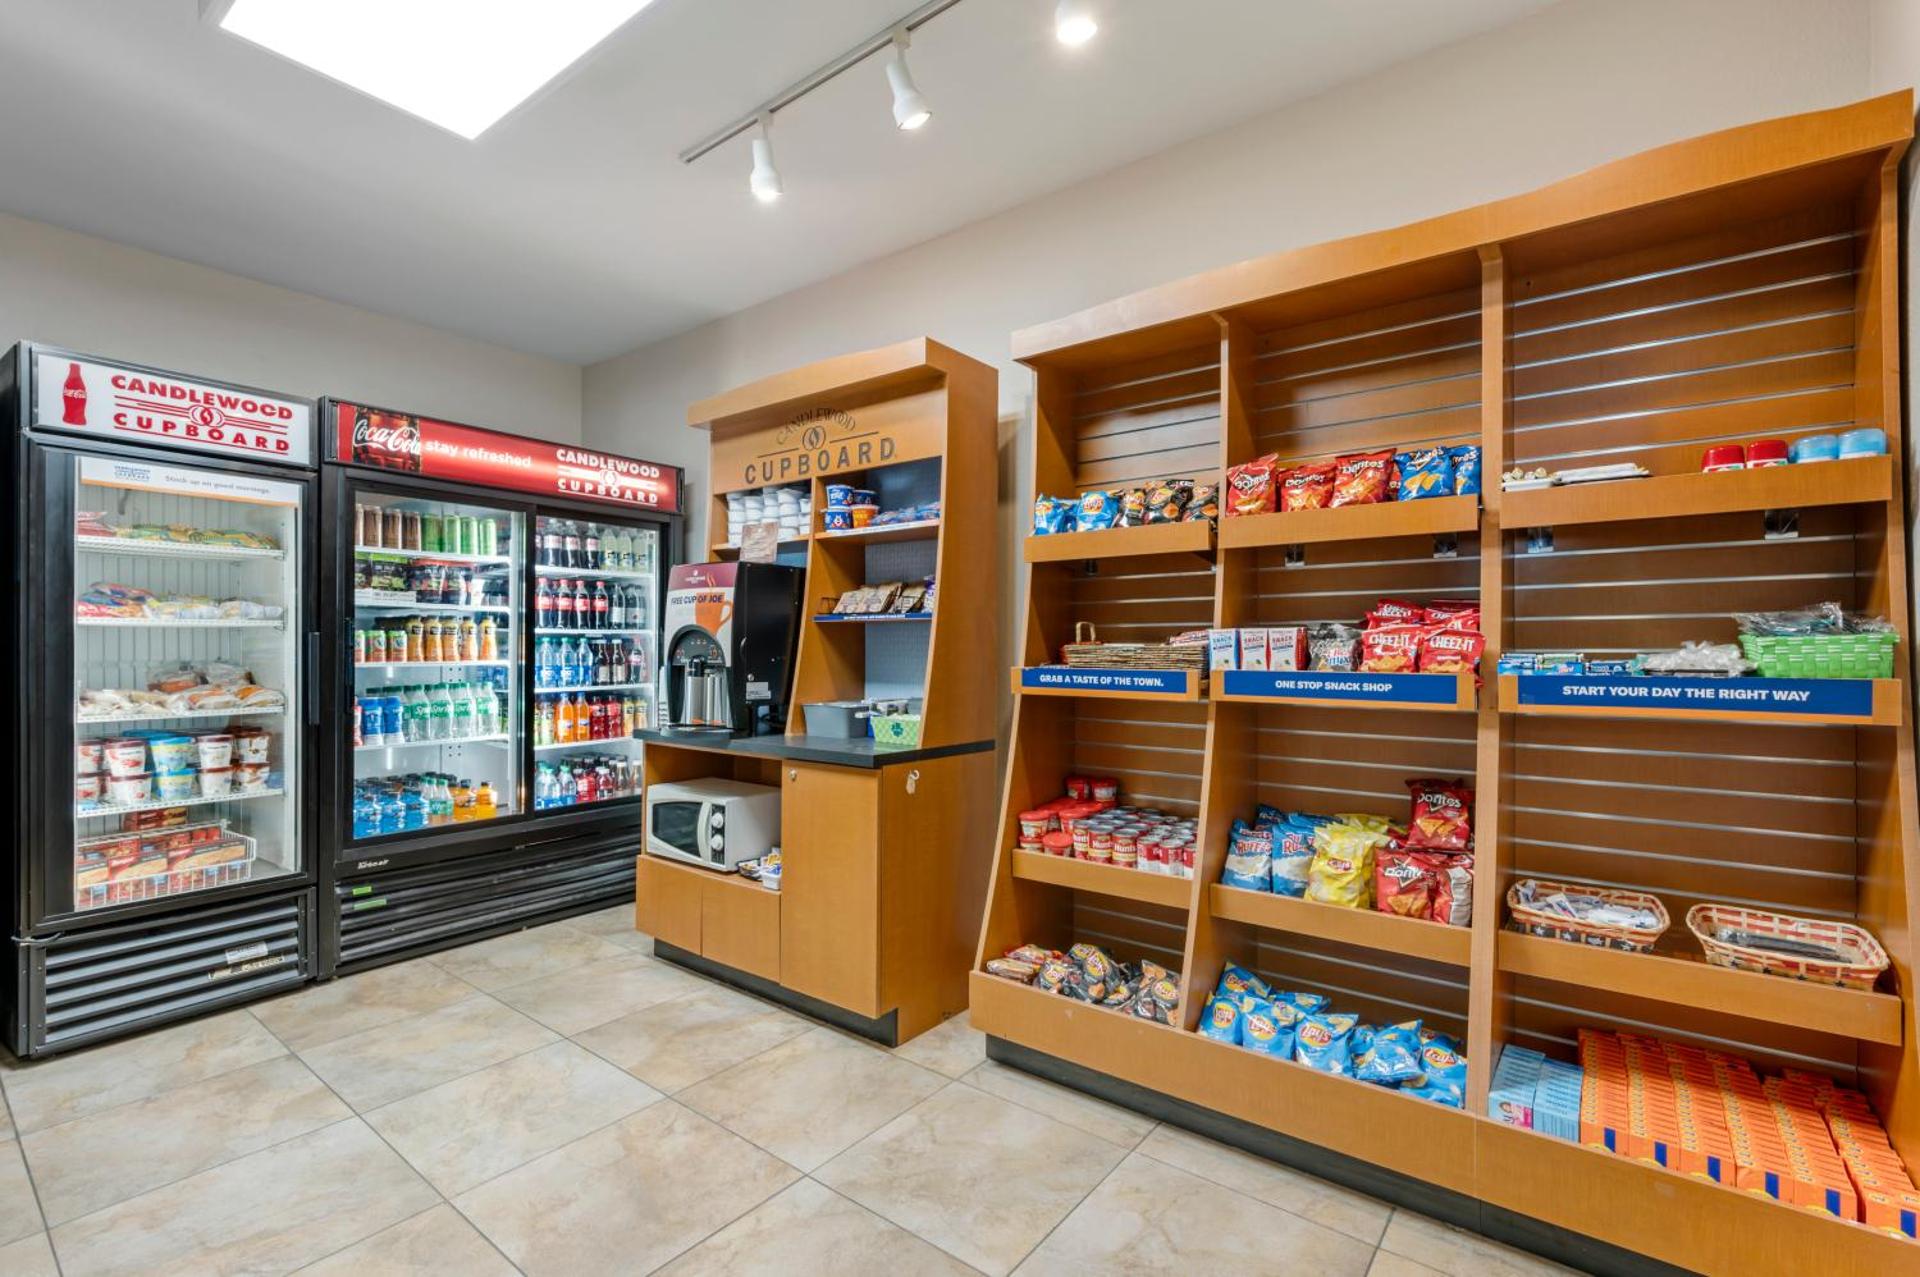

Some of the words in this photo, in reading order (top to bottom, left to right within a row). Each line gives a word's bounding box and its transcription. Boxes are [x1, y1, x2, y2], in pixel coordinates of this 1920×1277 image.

[110, 374, 293, 420] CANDLEWOOD
[113, 412, 290, 452] CUPBOARD
[776, 407, 856, 445] CANDLEWOOD
[425, 440, 459, 457] stay
[463, 447, 532, 467] refreshed
[556, 448, 660, 478] CANDLEWOOD
[745, 437, 896, 484] CUPBOARD
[1342, 459, 1385, 474] Doritos
[557, 478, 658, 504] CUPBOARD
[683, 595, 697, 604] CUP
[697, 594, 708, 604] OF
[1369, 632, 1411, 647] CHEEZ-IT
[1430, 634, 1476, 652] CHEEZ-IT
[1040, 675, 1063, 683] GRAB
[1073, 676, 1099, 684] TASTE
[1100, 676, 1112, 685] OF
[1114, 677, 1132, 686] THE
[1134, 678, 1164, 687] TOWN.
[1275, 680, 1296, 689] ONE
[1297, 681, 1323, 690] STOP
[1324, 681, 1361, 691] SNACK
[1362, 682, 1393, 692] SHOP
[1562, 685, 1607, 697] START
[1609, 686, 1650, 698] YOUR
[1652, 687, 1683, 699] DAY
[1684, 687, 1716, 699] THE
[1718, 688, 1768, 701] RIGHT
[1771, 690, 1810, 702] WAY
[1417, 792, 1462, 808] Doritos
[1301, 1021, 1332, 1043] Lay's
[1424, 1047, 1457, 1066] Lay's
